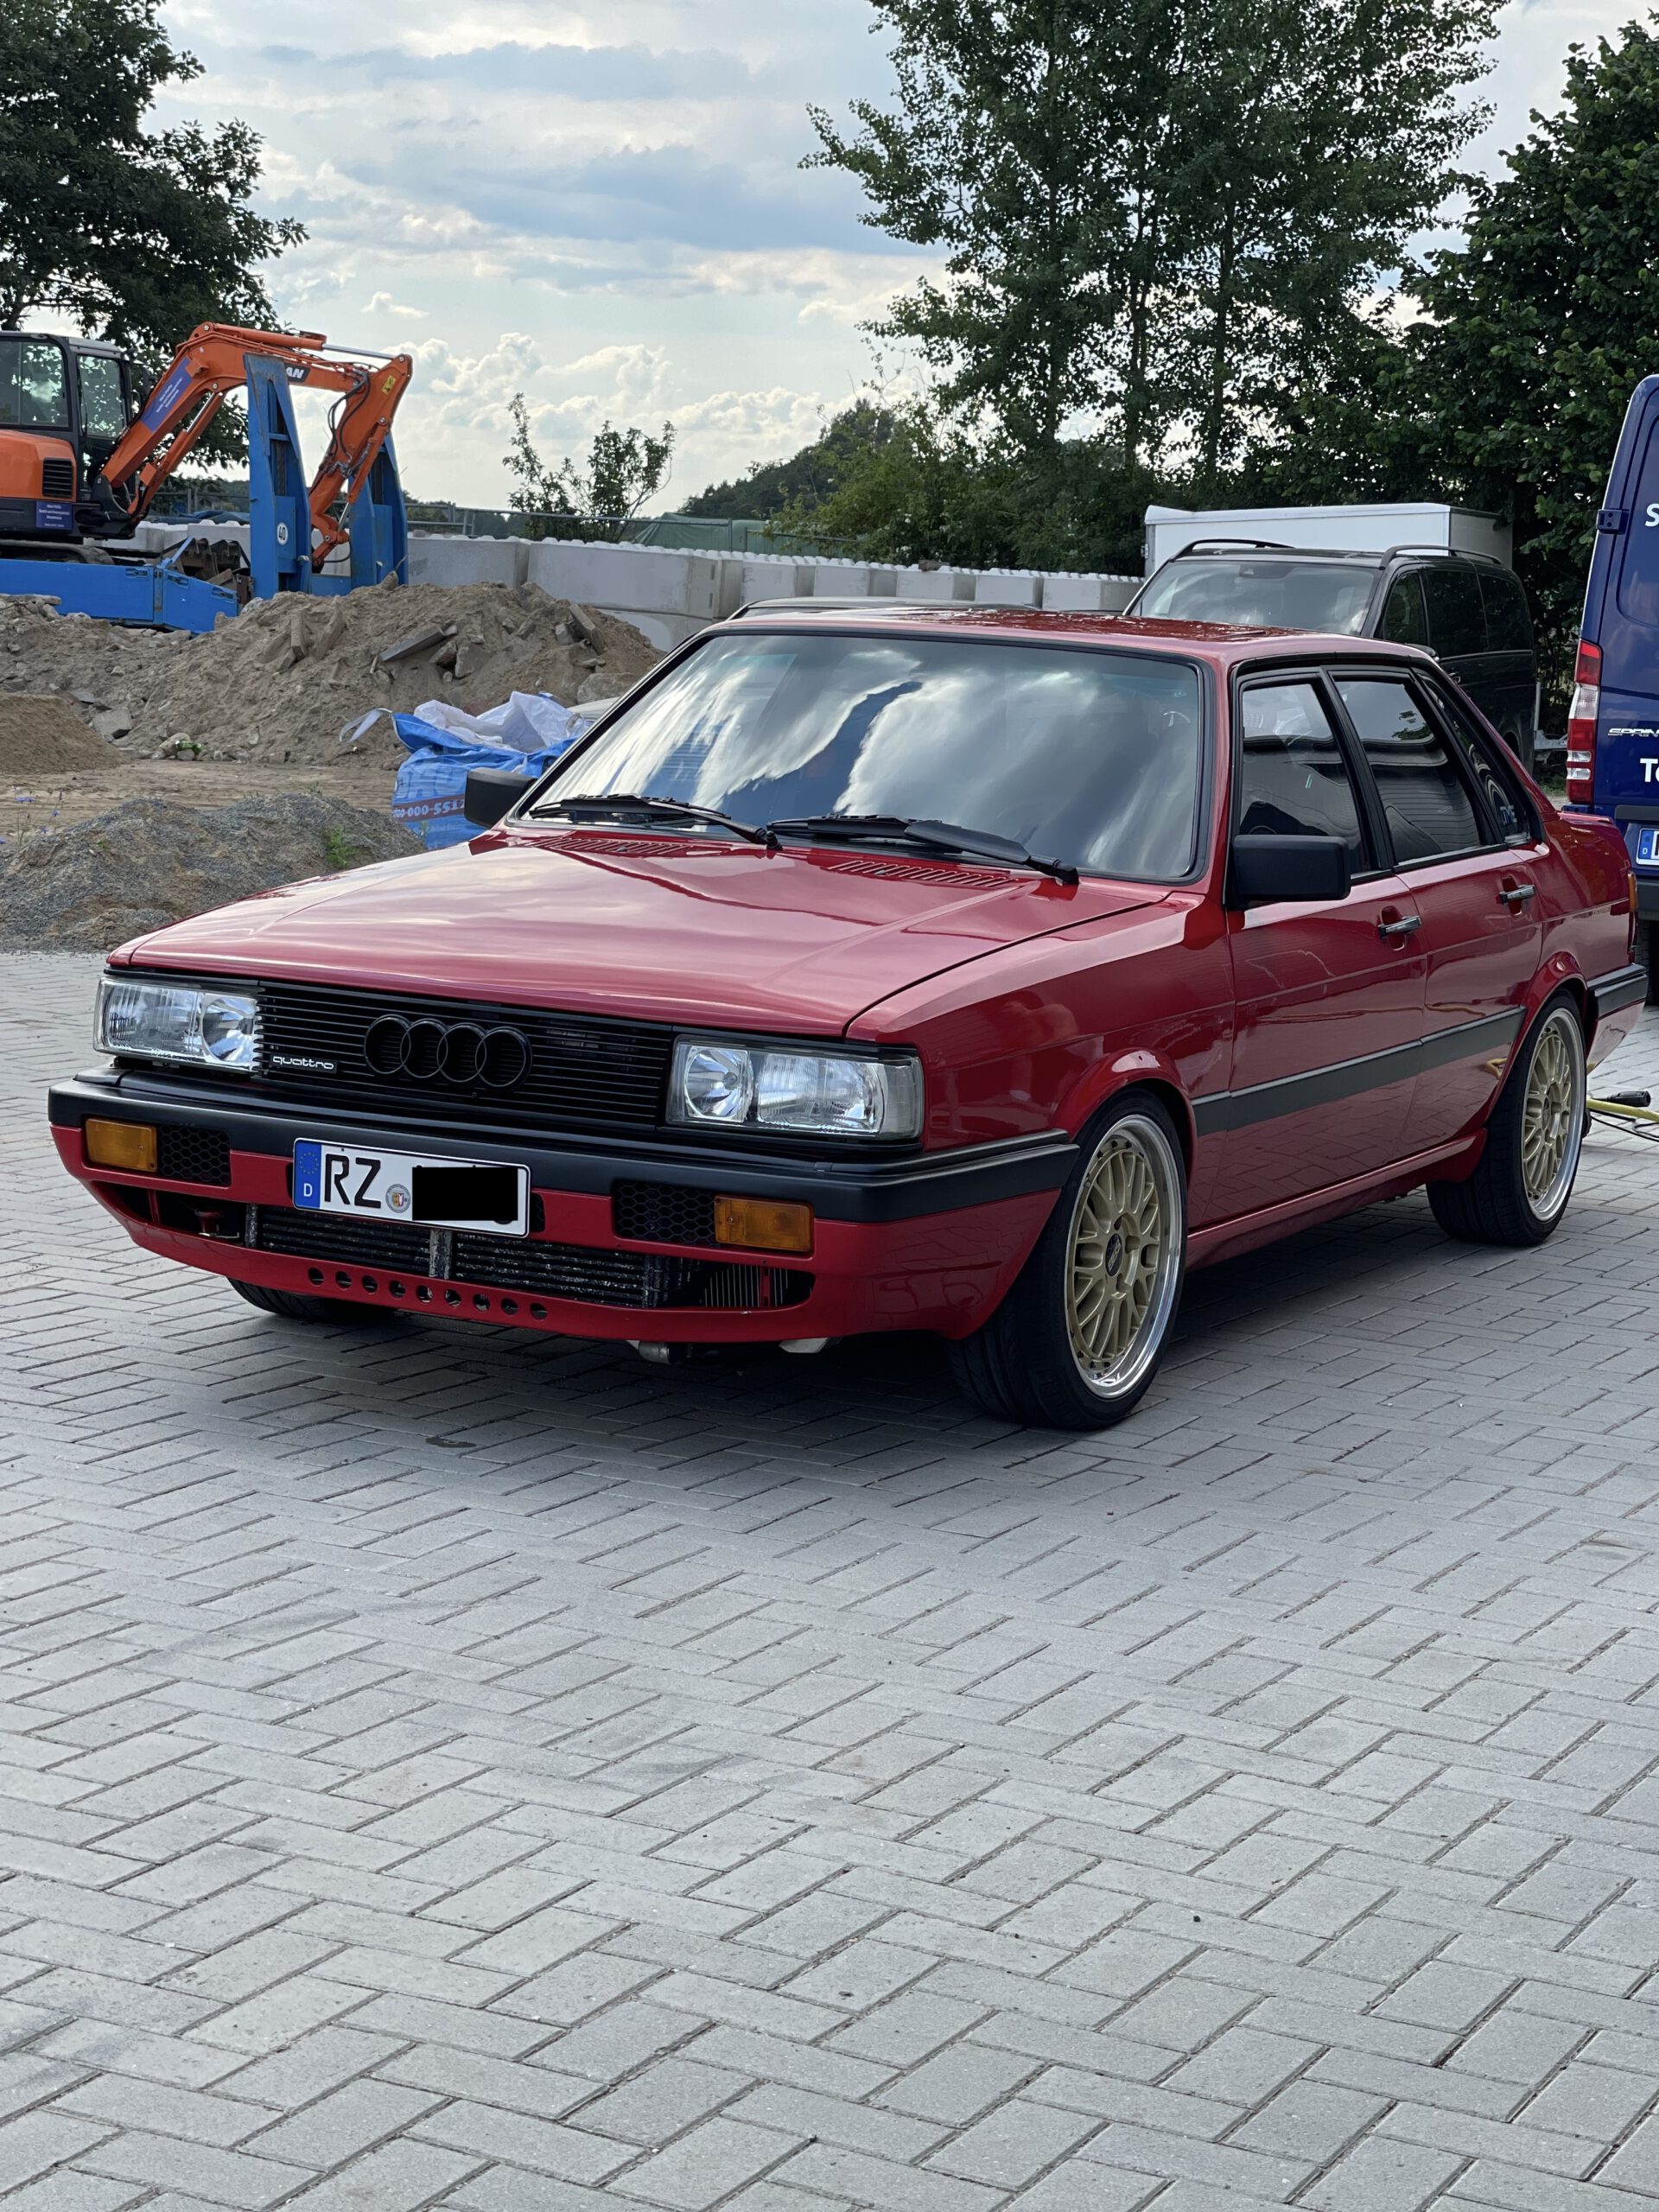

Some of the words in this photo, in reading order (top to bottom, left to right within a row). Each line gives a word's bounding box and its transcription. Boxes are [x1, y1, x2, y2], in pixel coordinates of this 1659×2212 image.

[1644, 503, 1659, 527] S
[278, 525, 286, 541] 40
[1639, 758, 1659, 783] T
[272, 1056, 334, 1070] quattro
[303, 1183, 313, 1198] D
[323, 1153, 382, 1209] RZ
